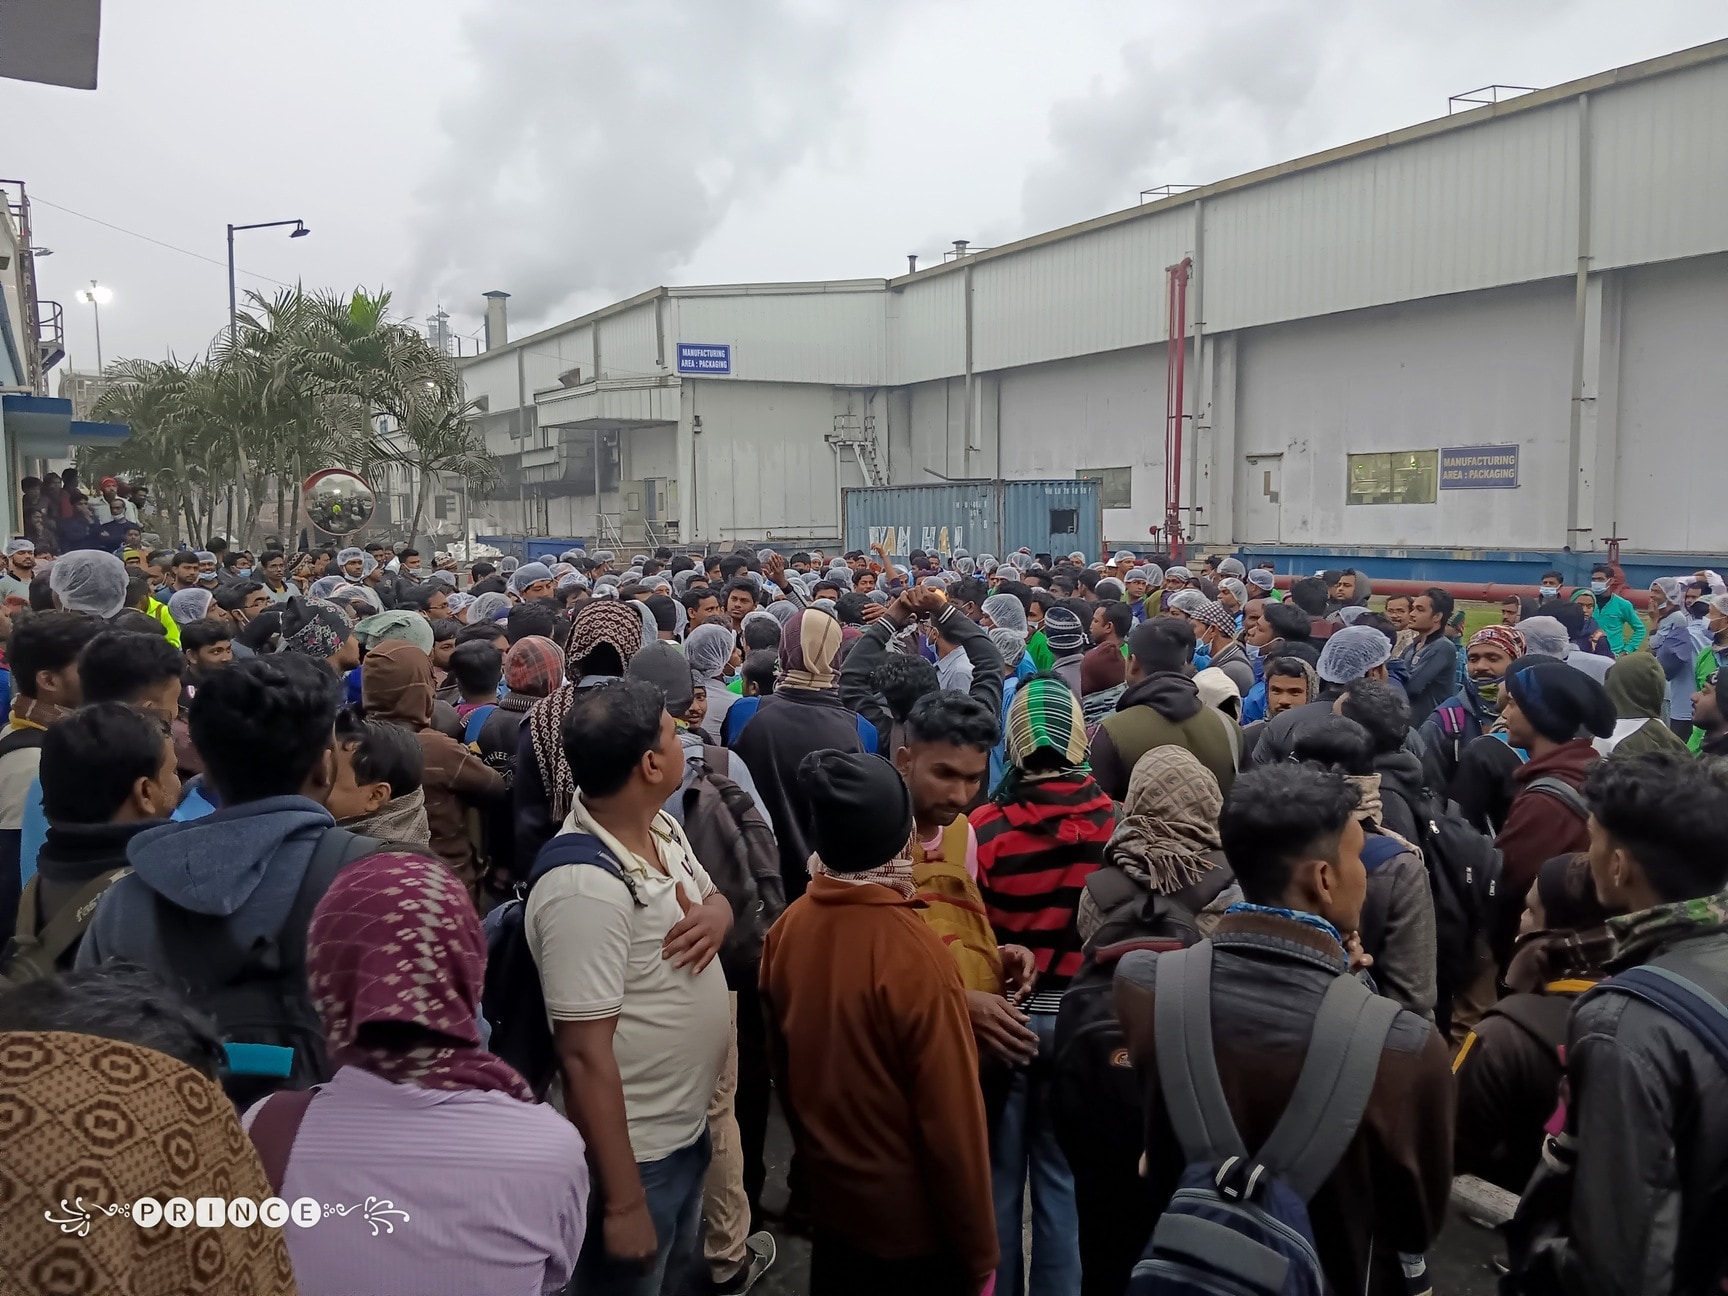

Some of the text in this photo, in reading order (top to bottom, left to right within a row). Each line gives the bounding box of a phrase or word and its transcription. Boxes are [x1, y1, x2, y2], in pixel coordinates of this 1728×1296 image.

[682, 348, 726, 358] MANUFACTURING
[681, 359, 695, 368] AREA
[699, 360, 727, 369] PACKAGING
[1443, 455, 1515, 467] MANUFACTURING
[1443, 470, 1463, 480] AREA
[1469, 468, 1515, 480] PACKAGING
[868, 526, 911, 557] WAN
[483, 751, 508, 766] THREE
